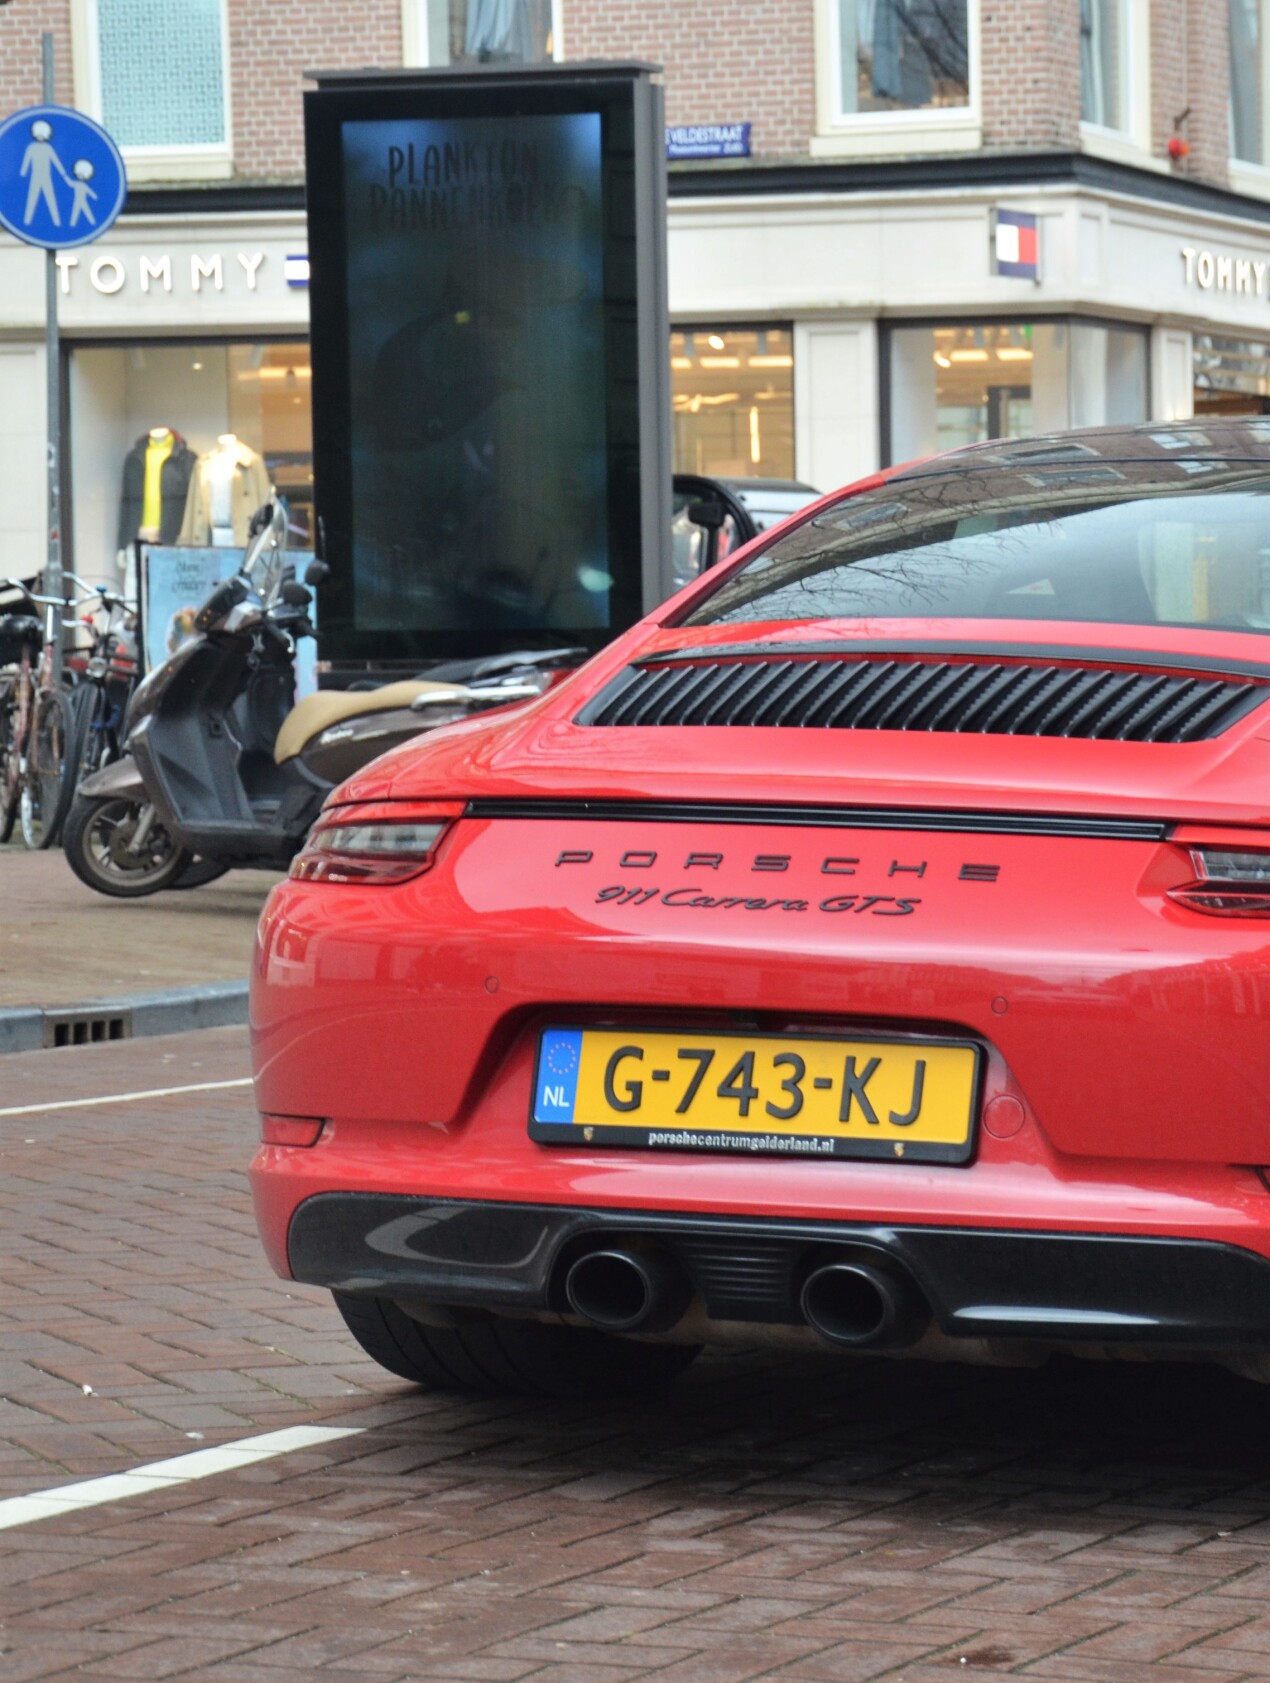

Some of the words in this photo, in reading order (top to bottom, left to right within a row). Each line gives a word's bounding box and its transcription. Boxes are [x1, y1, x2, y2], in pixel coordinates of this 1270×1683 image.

[388, 138, 539, 188] PLANKTON
[55, 253, 264, 294] TOMMY
[1182, 247, 1266, 295] TOMMY
[554, 850, 1001, 882] PORSCHE
[595, 885, 660, 905] 911
[661, 888, 810, 912] Carrera
[818, 894, 922, 916] GTS
[543, 1085, 570, 1108] NL
[603, 1045, 927, 1127] G-743-KJ
[648, 1131, 835, 1153] porschecentrumgelderland.nl
